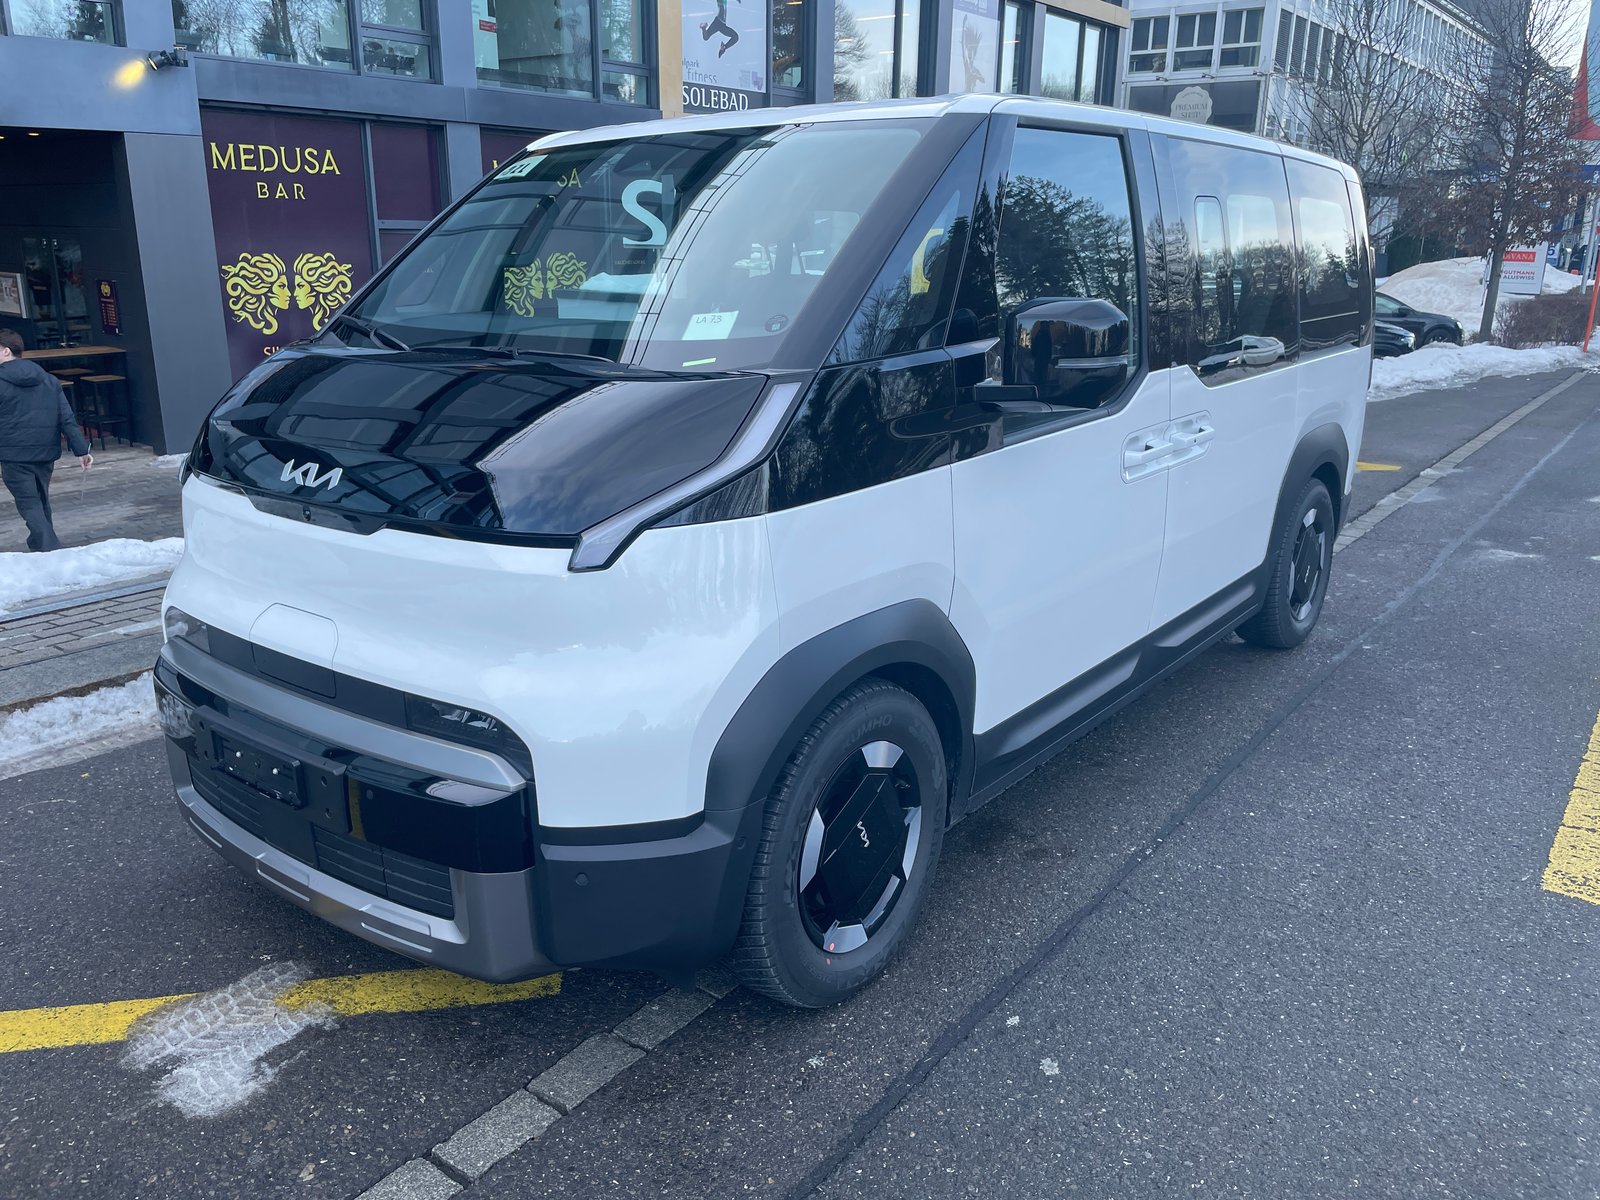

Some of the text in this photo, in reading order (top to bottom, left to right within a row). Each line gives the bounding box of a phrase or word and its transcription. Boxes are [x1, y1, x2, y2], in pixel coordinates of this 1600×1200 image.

[682, 85, 749, 111] SOLEBAD
[210, 142, 341, 175] MEDUSA
[256, 181, 306, 200] BAR
